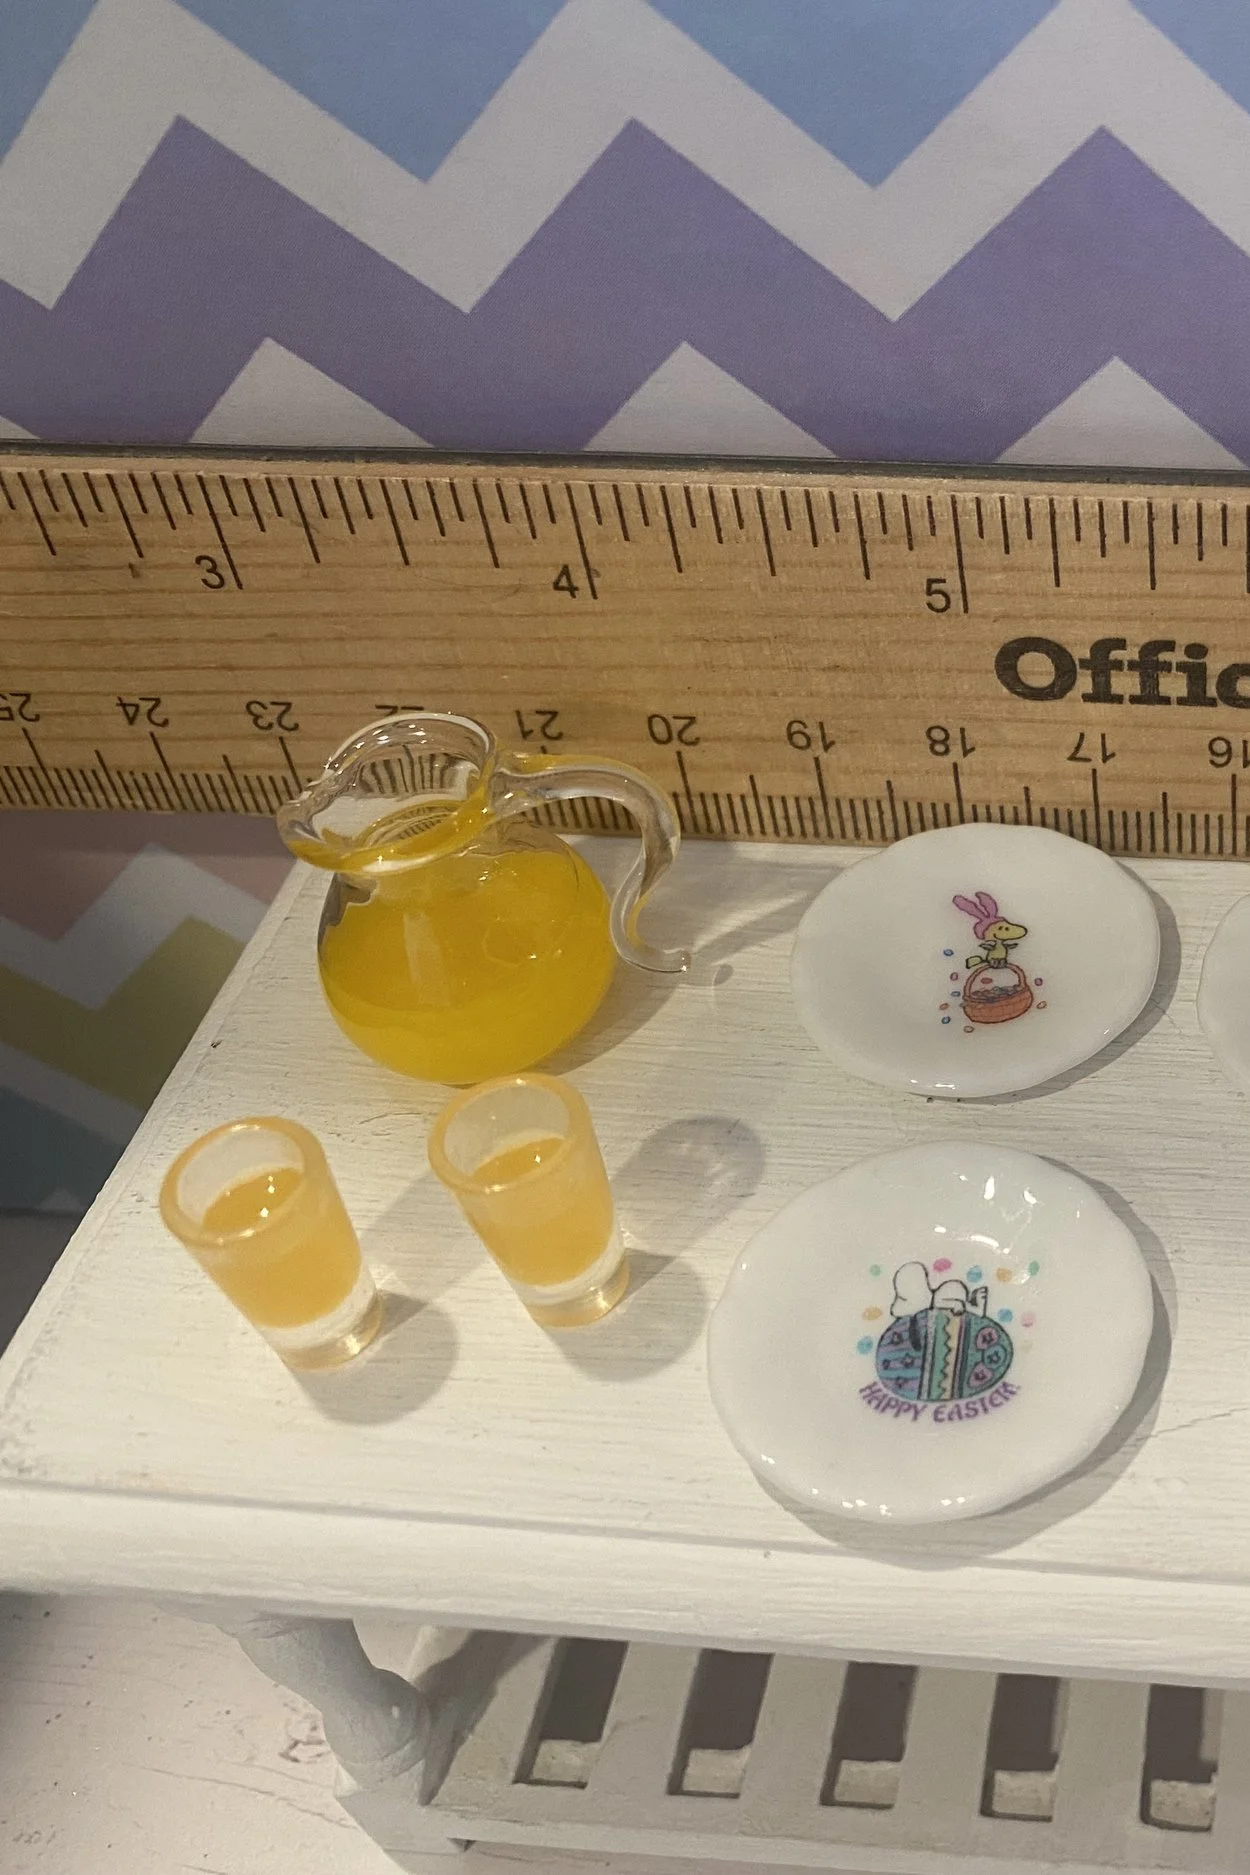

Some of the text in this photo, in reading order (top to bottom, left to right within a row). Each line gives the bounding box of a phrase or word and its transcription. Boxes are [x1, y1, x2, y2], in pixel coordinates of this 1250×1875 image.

[195, 555, 226, 590] 3
[553, 565, 577, 598] 4
[925, 578, 951, 613] 5
[116, 696, 169, 728] 24
[245, 700, 299, 732] 23
[514, 709, 564, 742] 21
[647, 713, 700, 747] 20
[785, 719, 836, 753] 19
[925, 724, 976, 759] 18
[1067, 732, 1117, 765] 17
[859, 1381, 929, 1423] HAPPY
